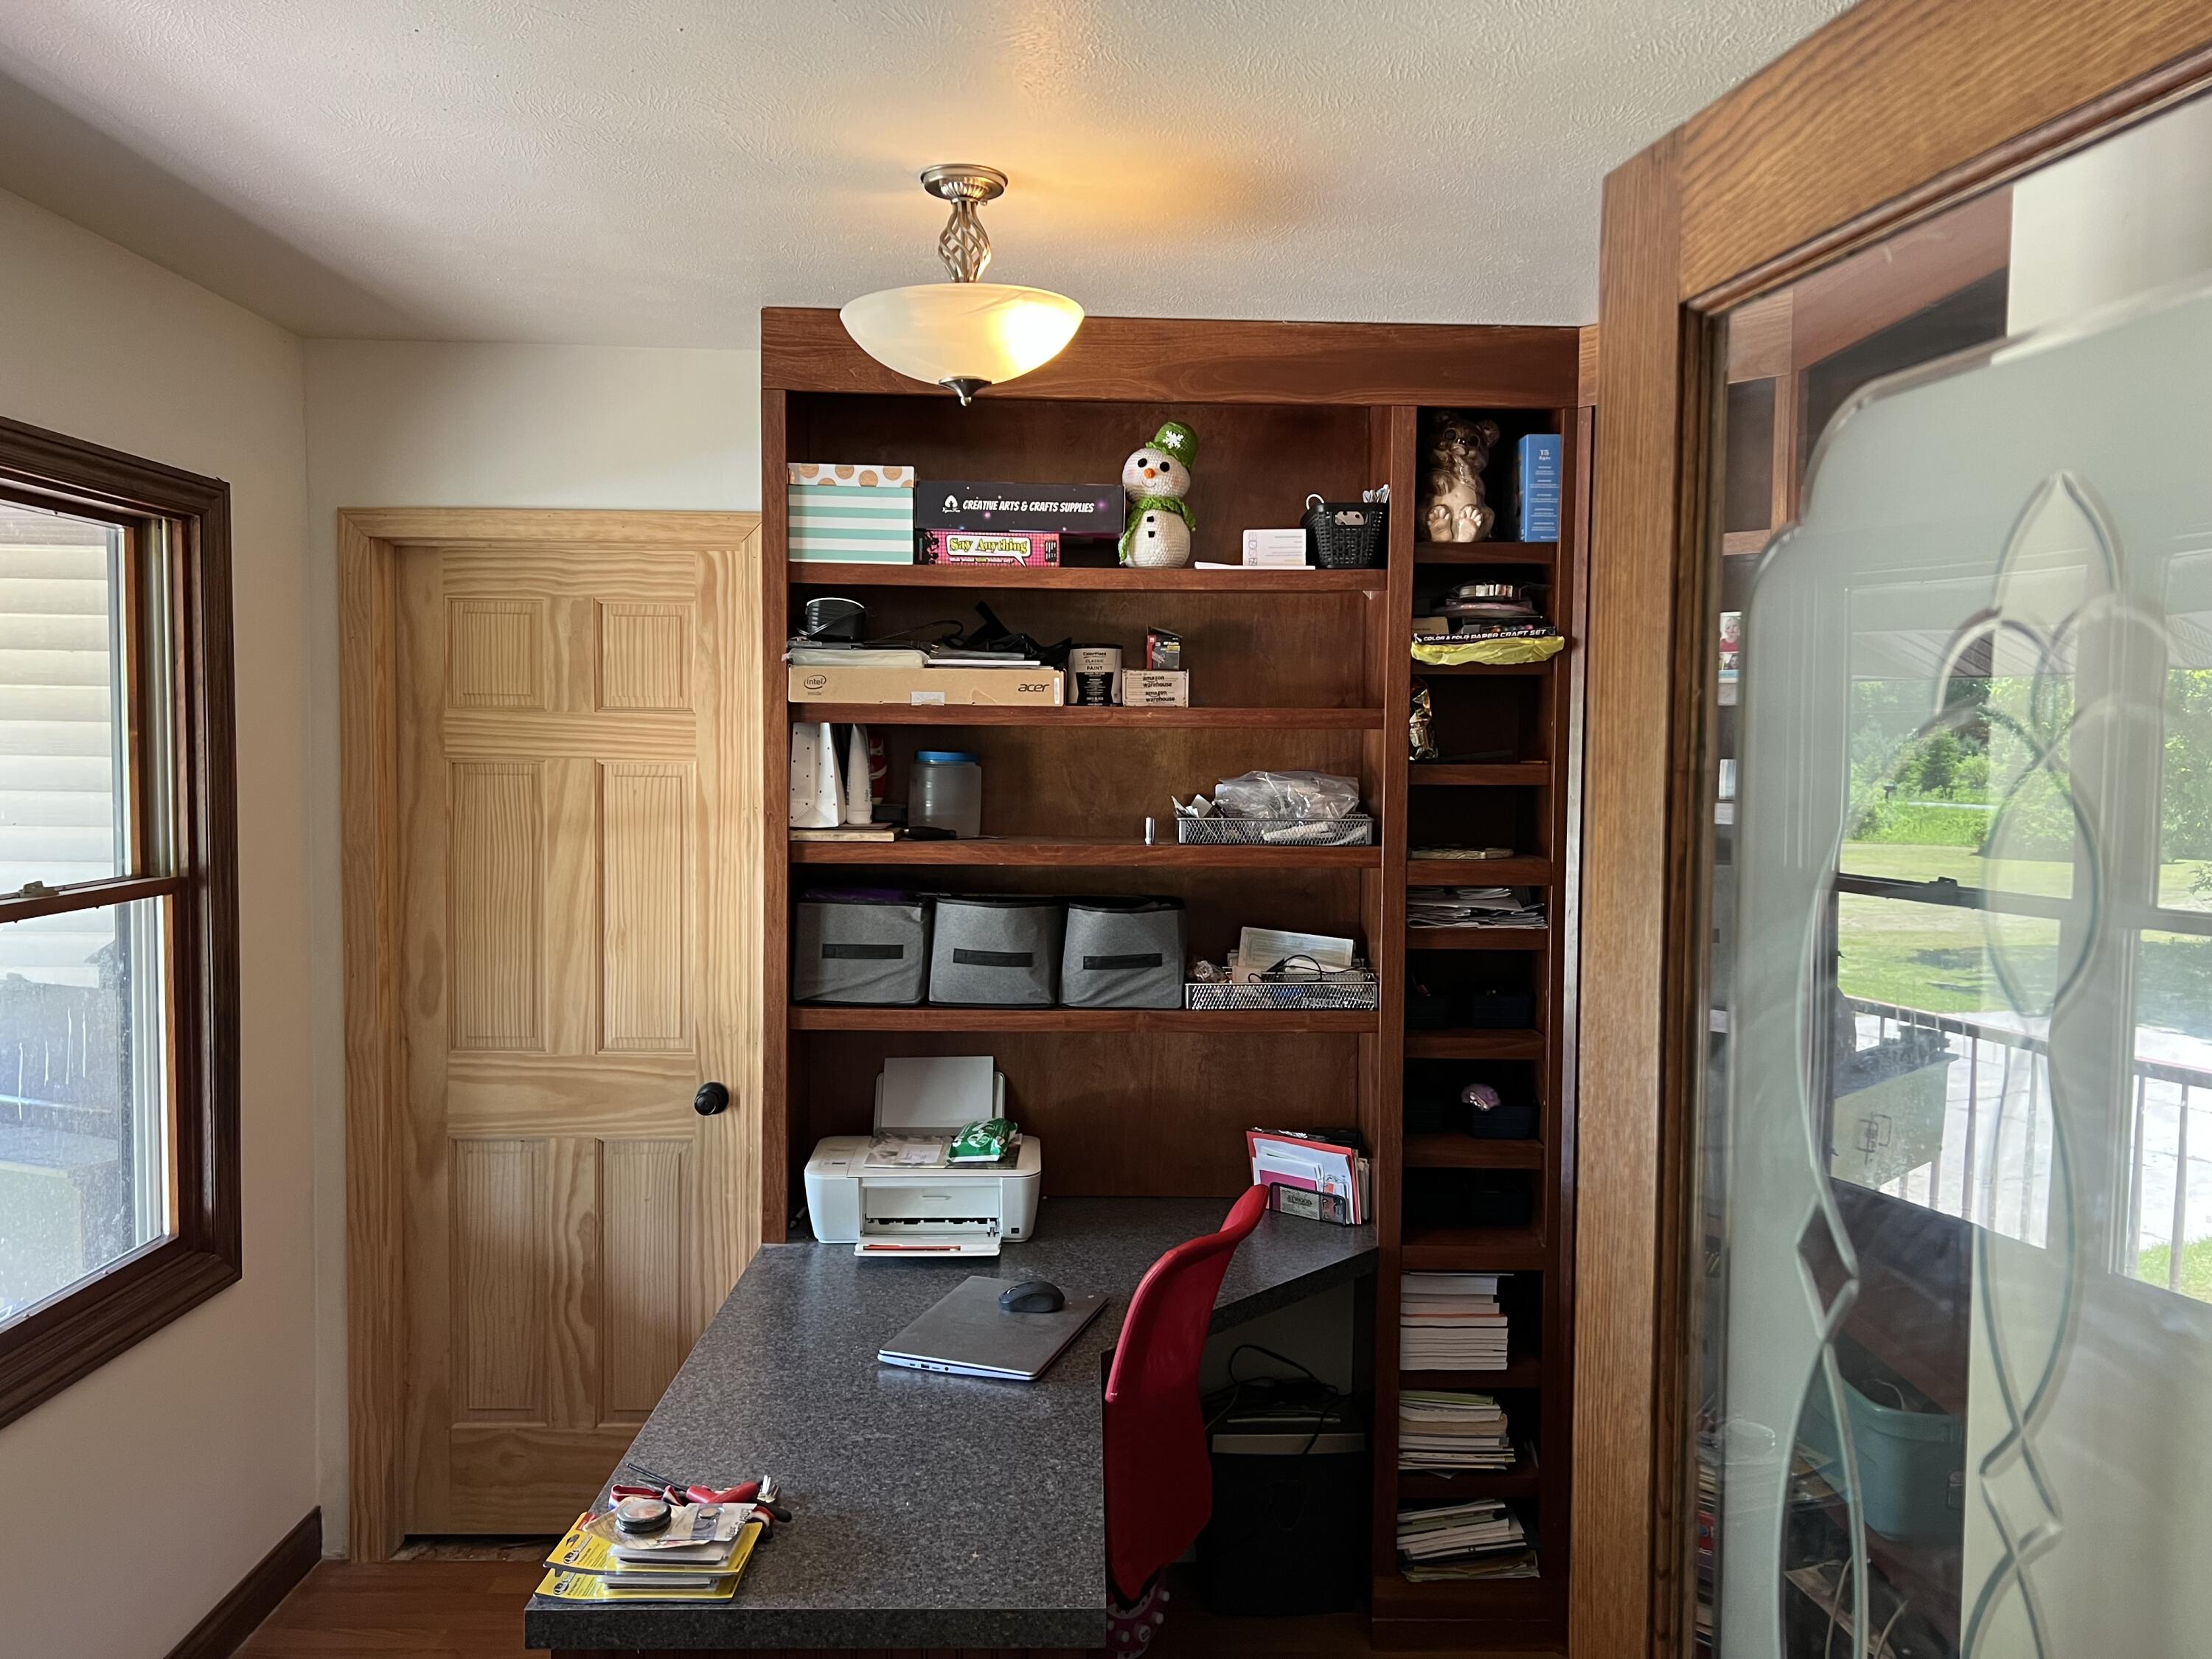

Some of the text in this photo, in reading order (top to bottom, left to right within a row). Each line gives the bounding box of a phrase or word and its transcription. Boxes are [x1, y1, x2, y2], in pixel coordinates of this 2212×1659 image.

[962, 500, 1094, 513] CREATIVE ARTS & CRAFTS SUPPLIES
[950, 538, 973, 552] Say
[975, 538, 1028, 554] Anything
[1018, 684, 1050, 692] acer
